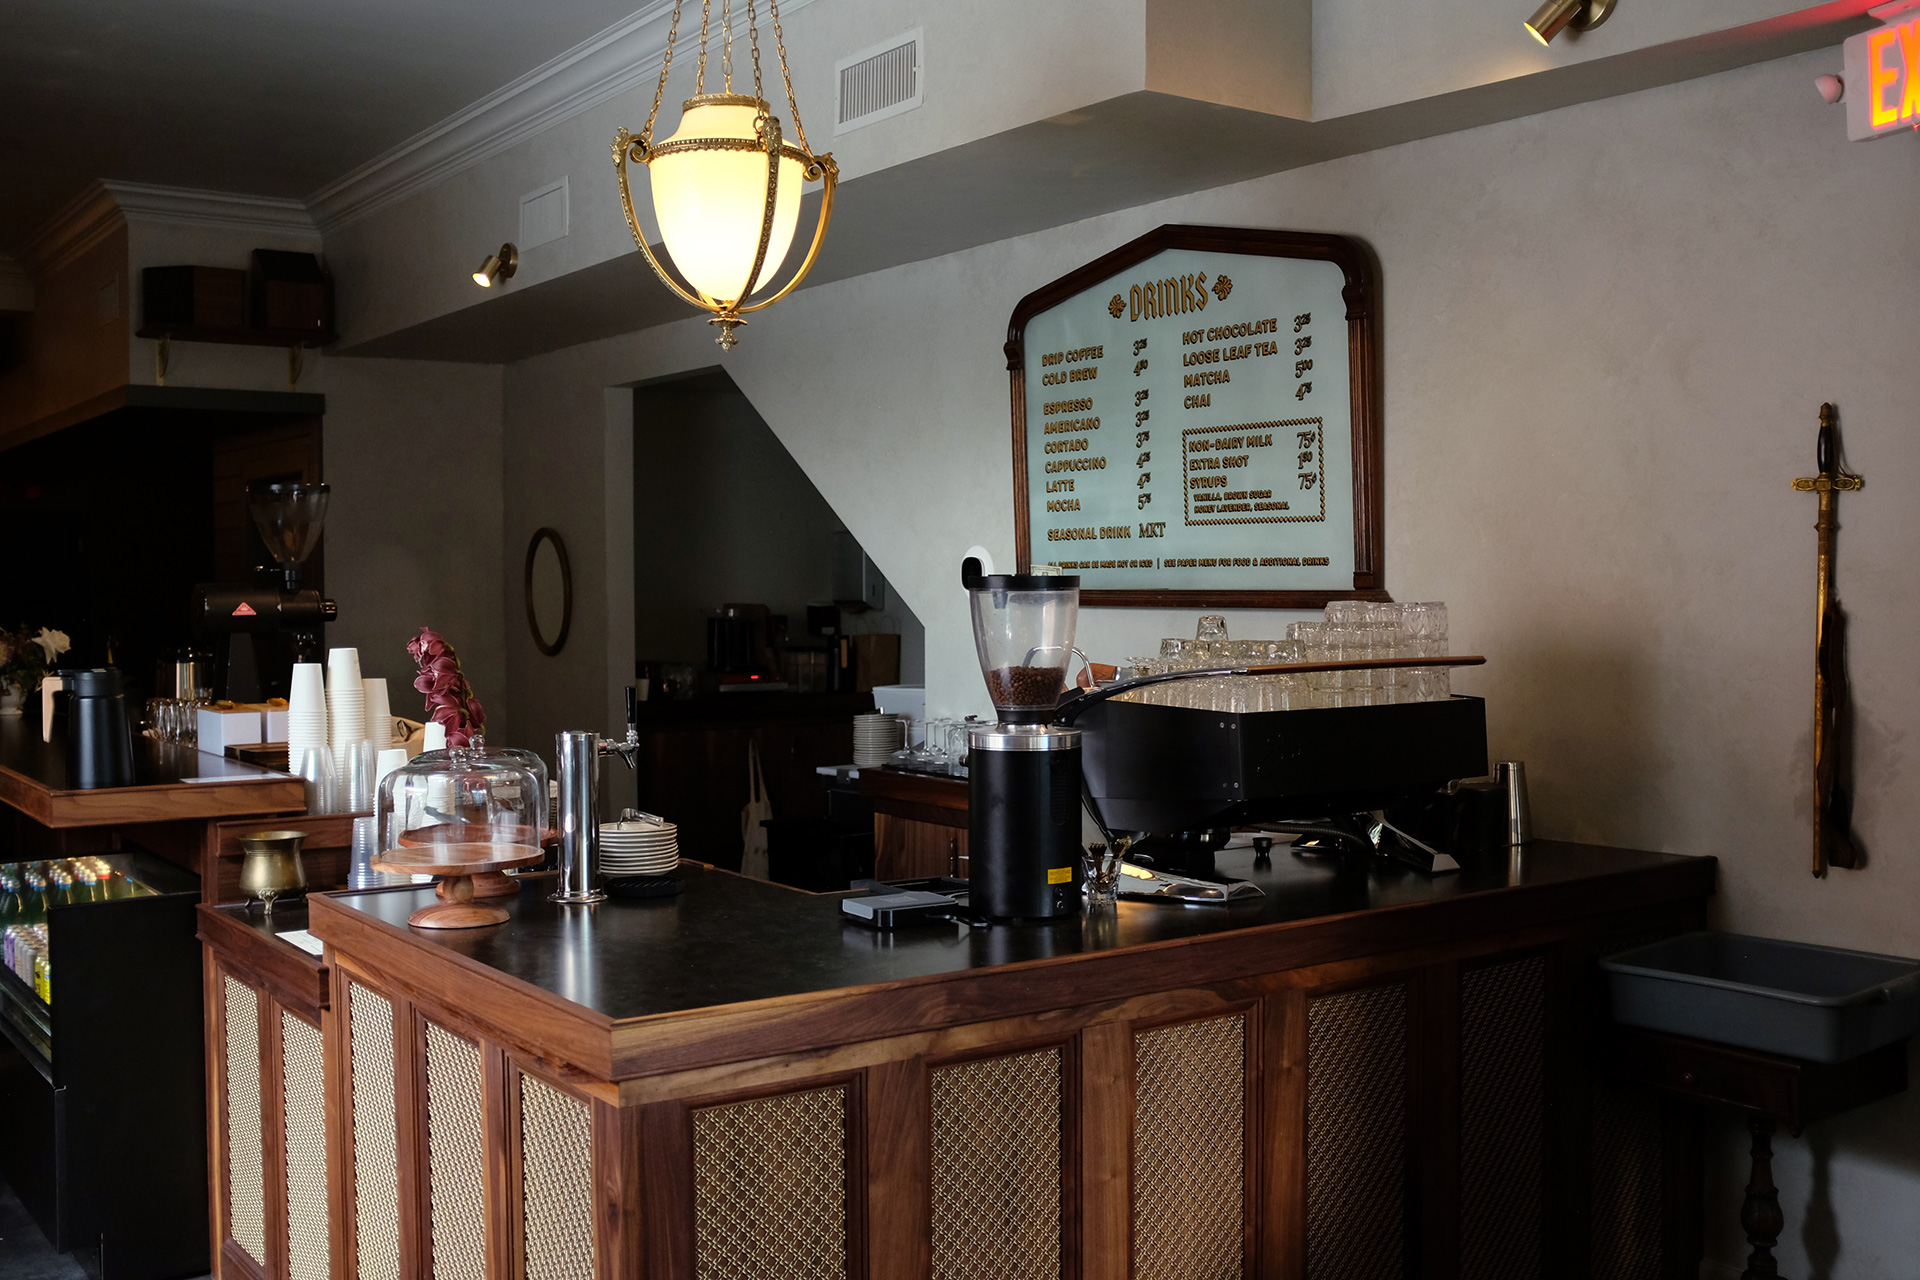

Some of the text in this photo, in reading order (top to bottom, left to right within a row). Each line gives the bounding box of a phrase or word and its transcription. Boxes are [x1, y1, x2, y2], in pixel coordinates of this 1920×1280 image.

[1867, 19, 1920, 130] EX
[1130, 271, 1208, 322] DRINKS
[1182, 318, 1277, 345] HOT CHOCOLATE
[1042, 345, 1104, 367] DRIP COFFEE
[1183, 341, 1278, 366] LOOSE LEAF TEA
[1042, 367, 1098, 386] COLD BREW
[1184, 370, 1231, 388] MATCHA
[1043, 397, 1093, 415] ESPRESSO
[1184, 393, 1212, 409] CHAI
[1044, 416, 1101, 435] AMERICANO
[1044, 438, 1089, 454] CORTADO
[1189, 434, 1273, 452] NON-DAIRY MILK
[1045, 456, 1107, 474] CAPPUCCINO
[1189, 455, 1249, 471] EXTRA SHOT
[1046, 479, 1075, 493] LATTE
[1190, 475, 1228, 489] SYRUPS
[1224, 491, 1248, 500] BROWN
[1249, 489, 1272, 499] SUGAR
[1047, 498, 1081, 512] MOCHA
[1194, 501, 1290, 513] HONEY LAVENDER, SEASONAL
[1048, 522, 1166, 541] SEASONAL DRINK MKT
[1058, 561, 1078, 569] DRINKS
[1079, 561, 1090, 569] CAN
[1100, 560, 1116, 568] MADE
[1117, 560, 1129, 568] HOT
[1130, 560, 1137, 568] OR
[1139, 559, 1153, 568] ICED
[1164, 559, 1176, 567] SEE
[1177, 558, 1197, 567] PAPER
[1199, 558, 1217, 567] MENU
[1219, 558, 1231, 567] FOR
[1233, 557, 1251, 566] FOOD
[1252, 558, 1258, 566] &
[1260, 557, 1301, 567] ADDITIONAL
[1302, 557, 1330, 566] DRINKS
